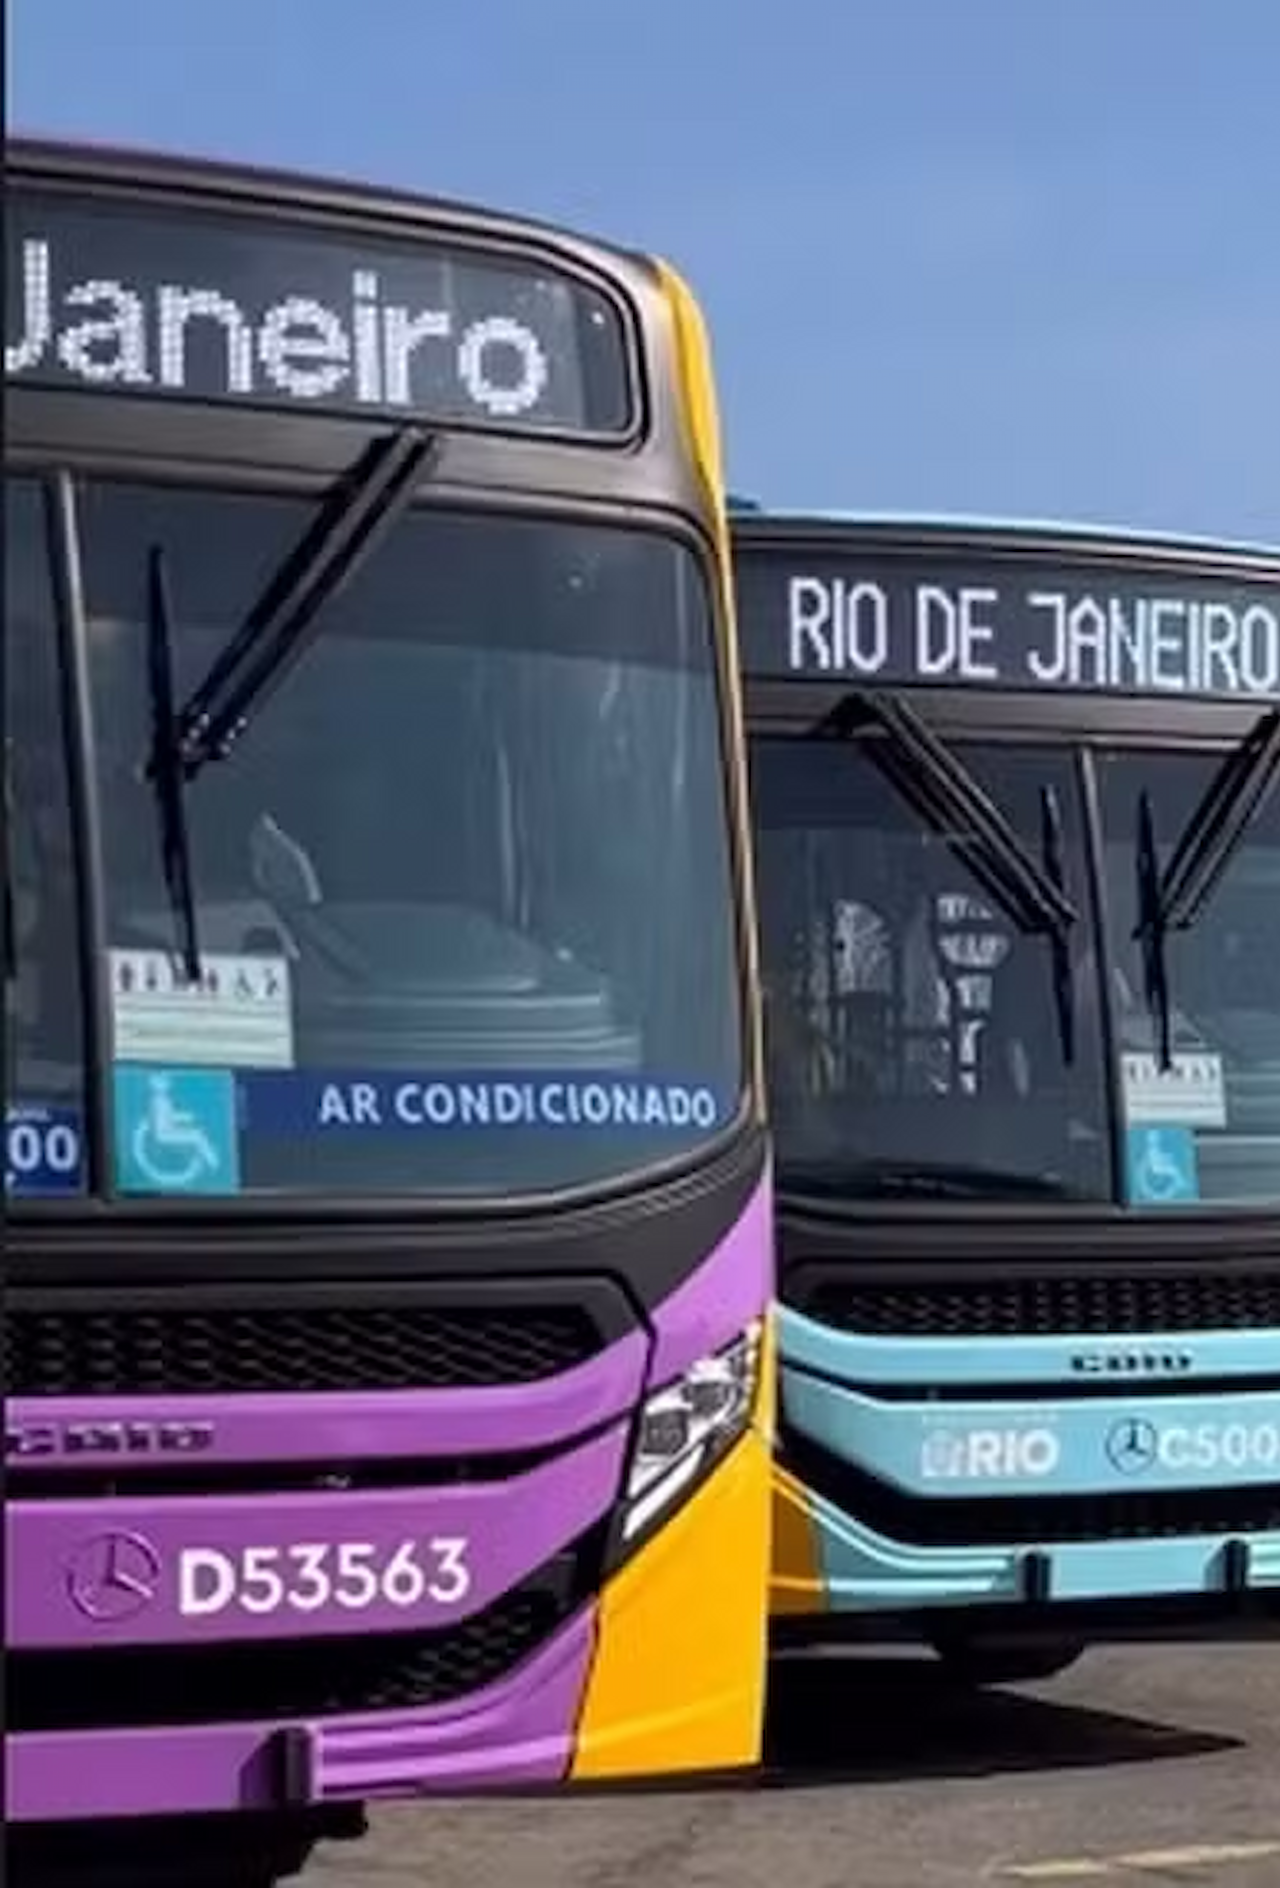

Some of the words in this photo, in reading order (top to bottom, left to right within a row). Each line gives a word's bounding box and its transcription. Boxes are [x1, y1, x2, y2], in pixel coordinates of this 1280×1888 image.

[5, 239, 547, 413] Janeiro
[789, 576, 888, 671] RIO
[917, 586, 998, 678] DE
[1027, 594, 1278, 692] JANEIRO
[319, 1084, 382, 1124] AR
[395, 1083, 717, 1128] CONDICIONADO
[8, 1125, 78, 1171] 00
[967, 1429, 1060, 1478] RIO
[180, 1538, 470, 1614] D53563
